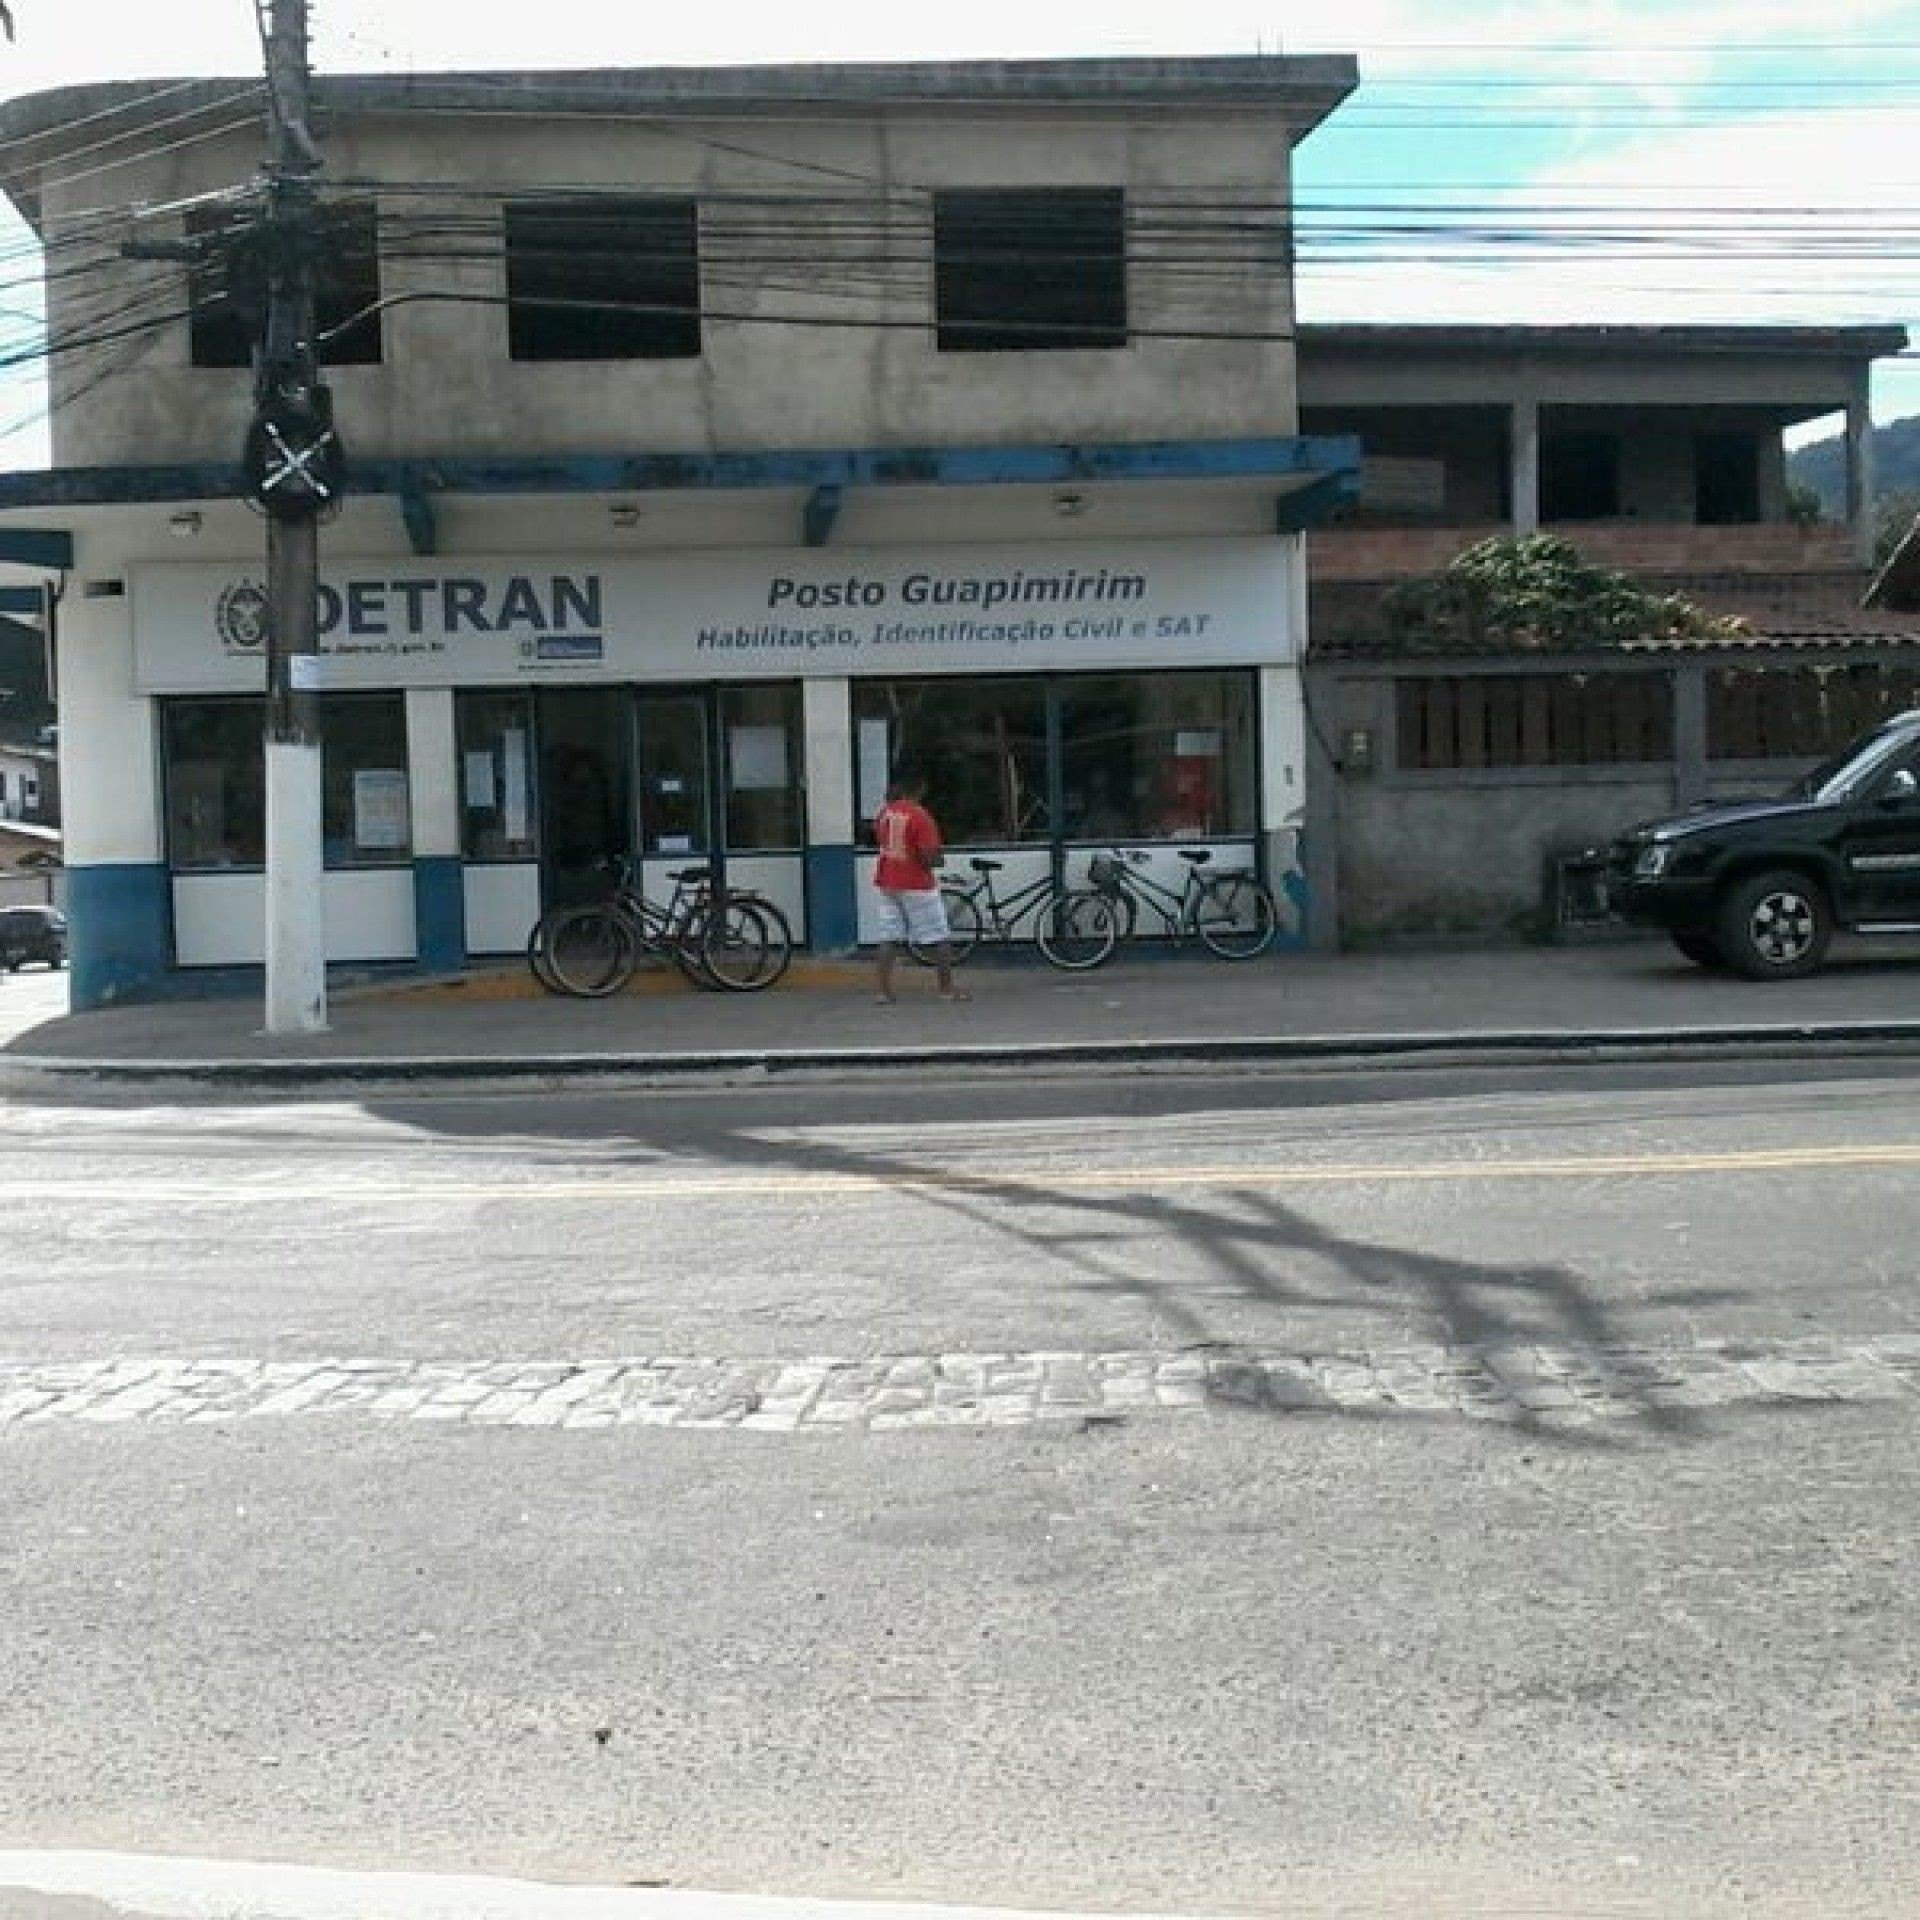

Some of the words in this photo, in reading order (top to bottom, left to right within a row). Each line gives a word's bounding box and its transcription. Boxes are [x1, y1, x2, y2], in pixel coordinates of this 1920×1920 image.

[767, 576, 887, 609] Posto
[902, 569, 1146, 611] Guapimirim
[697, 623, 861, 650] Habilitação,
[872, 616, 1054, 643] Identificação
[1064, 616, 1124, 640] Civil
[1132, 620, 1147, 640] e
[1154, 613, 1211, 638] SAT
